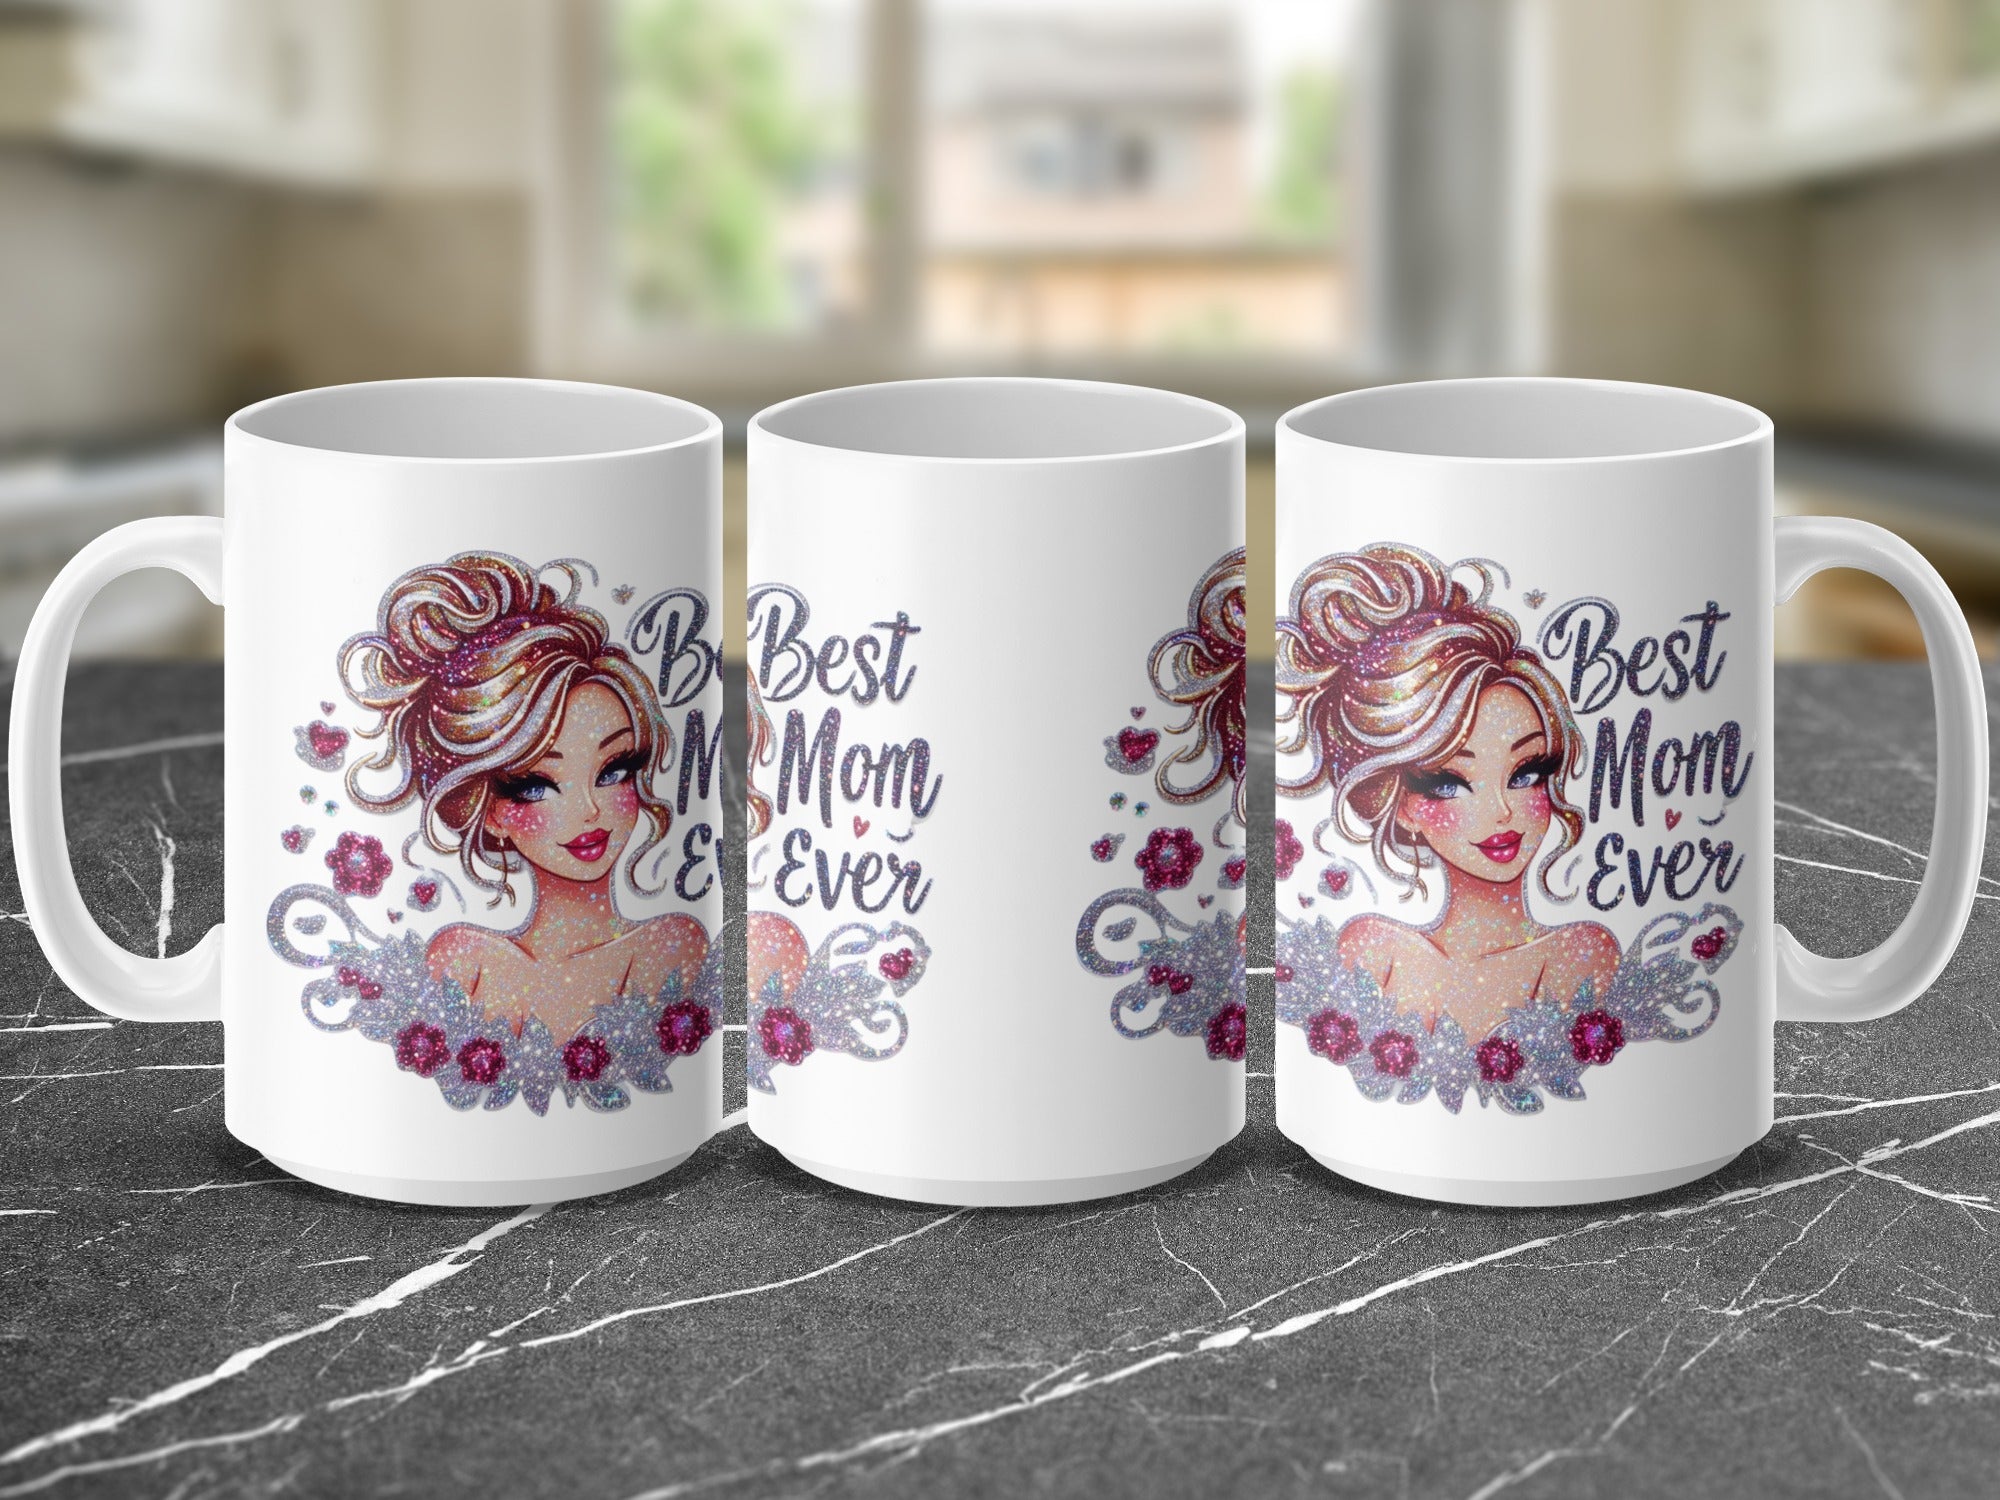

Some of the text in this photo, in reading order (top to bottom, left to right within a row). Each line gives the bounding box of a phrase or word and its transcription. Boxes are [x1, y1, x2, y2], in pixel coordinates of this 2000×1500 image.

[747, 583, 921, 706] Best
[1536, 596, 1731, 714] Best
[777, 706, 943, 829] Mom
[1588, 707, 1754, 828] Mom
[774, 827, 934, 915] Ever
[1586, 832, 1746, 912] Ever
